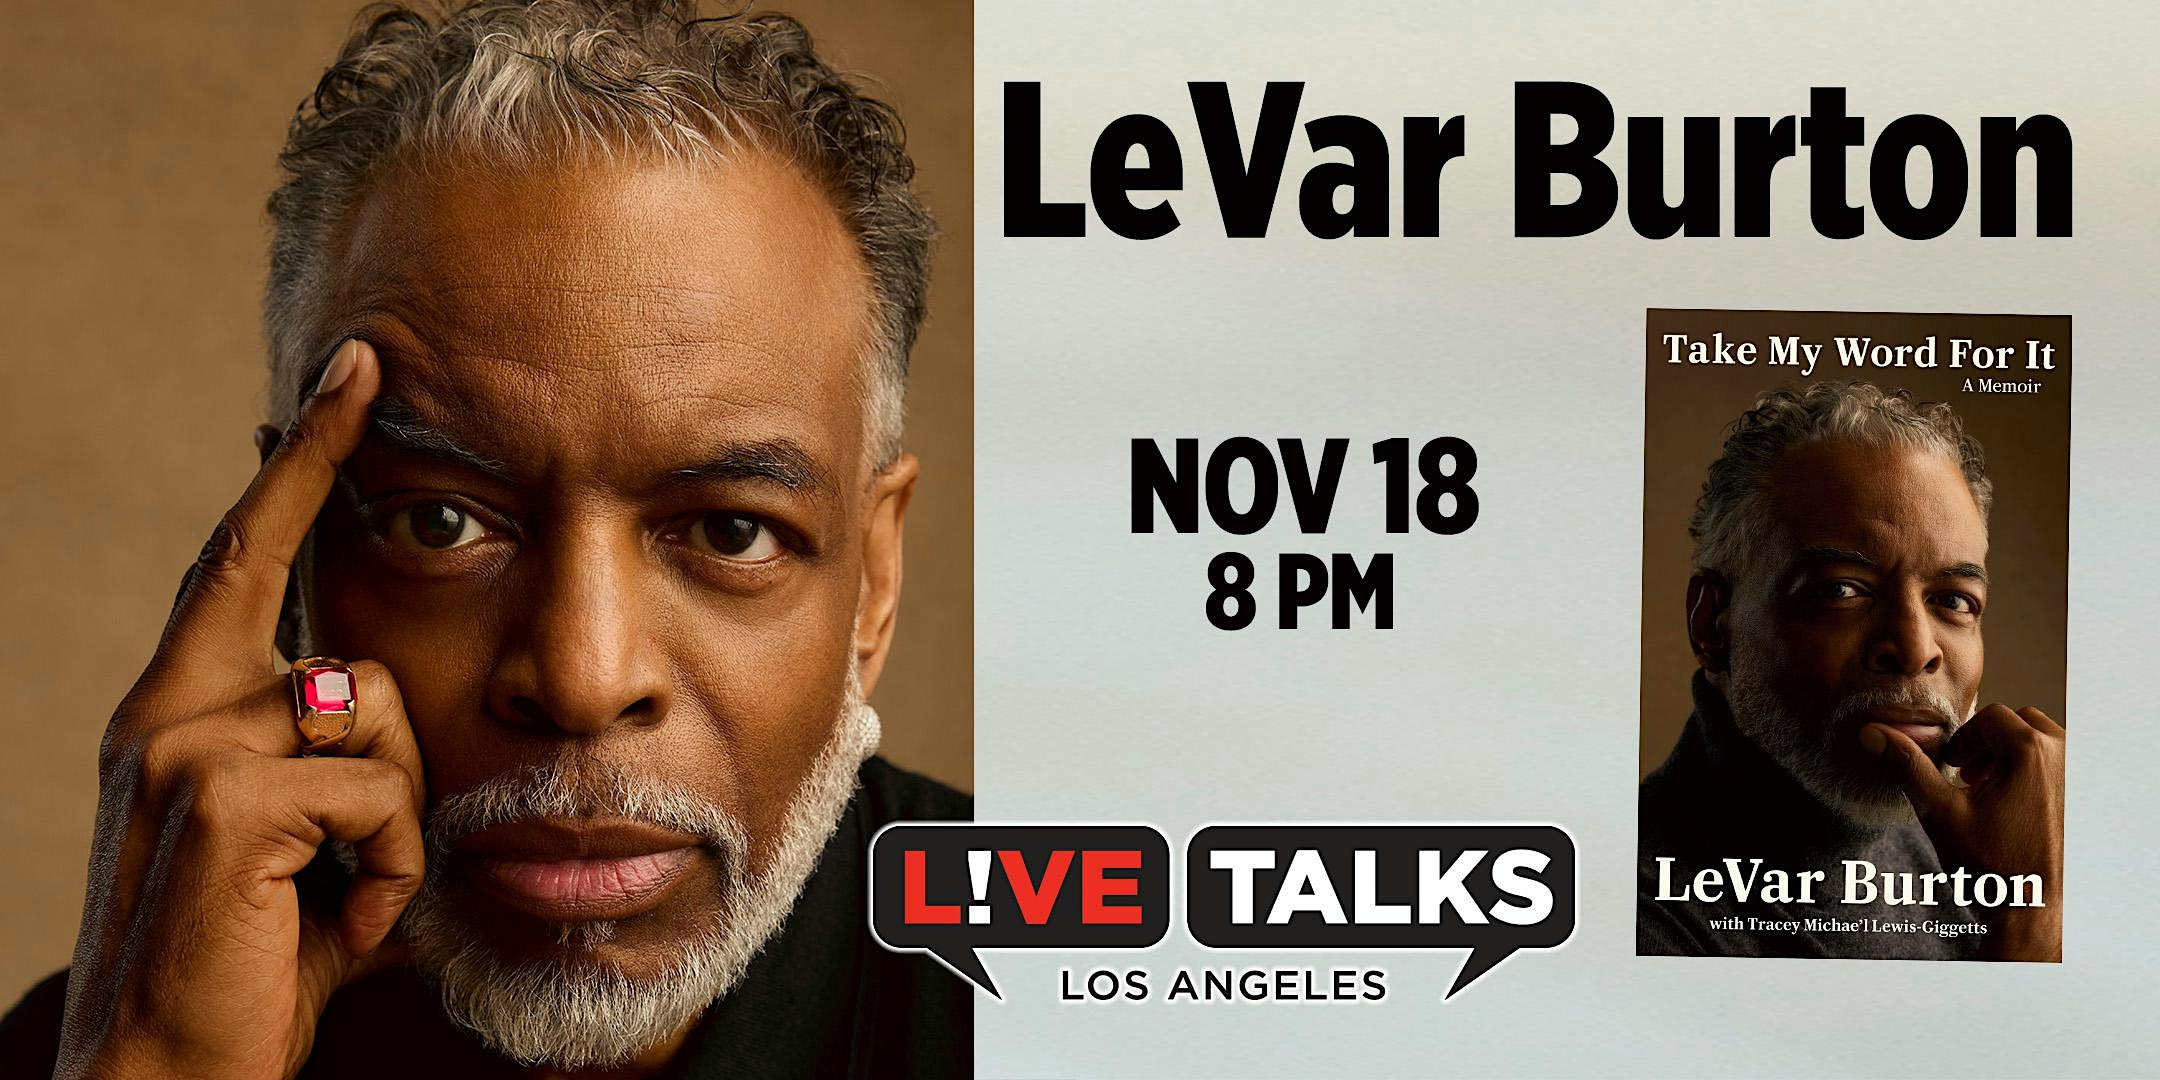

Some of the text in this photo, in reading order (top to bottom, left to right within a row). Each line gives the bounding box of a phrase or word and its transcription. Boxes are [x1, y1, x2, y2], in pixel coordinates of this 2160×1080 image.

[1004, 82, 2072, 240] LeVar Burton
[1664, 333, 2055, 376] Take My Word For It
[1962, 379, 2041, 393] A Memoir
[1132, 437, 1479, 535] NOV 18
[1206, 552, 1393, 631] 8 PM
[1211, 849, 1553, 925] TALKS
[1655, 857, 2045, 907] LeVar Burton
[1710, 917, 1743, 929] with
[1748, 918, 1800, 934] Tracey
[1872, 920, 1987, 937] Lewis-Giggetts
[1063, 971, 1385, 1000] LOS ANGELES
